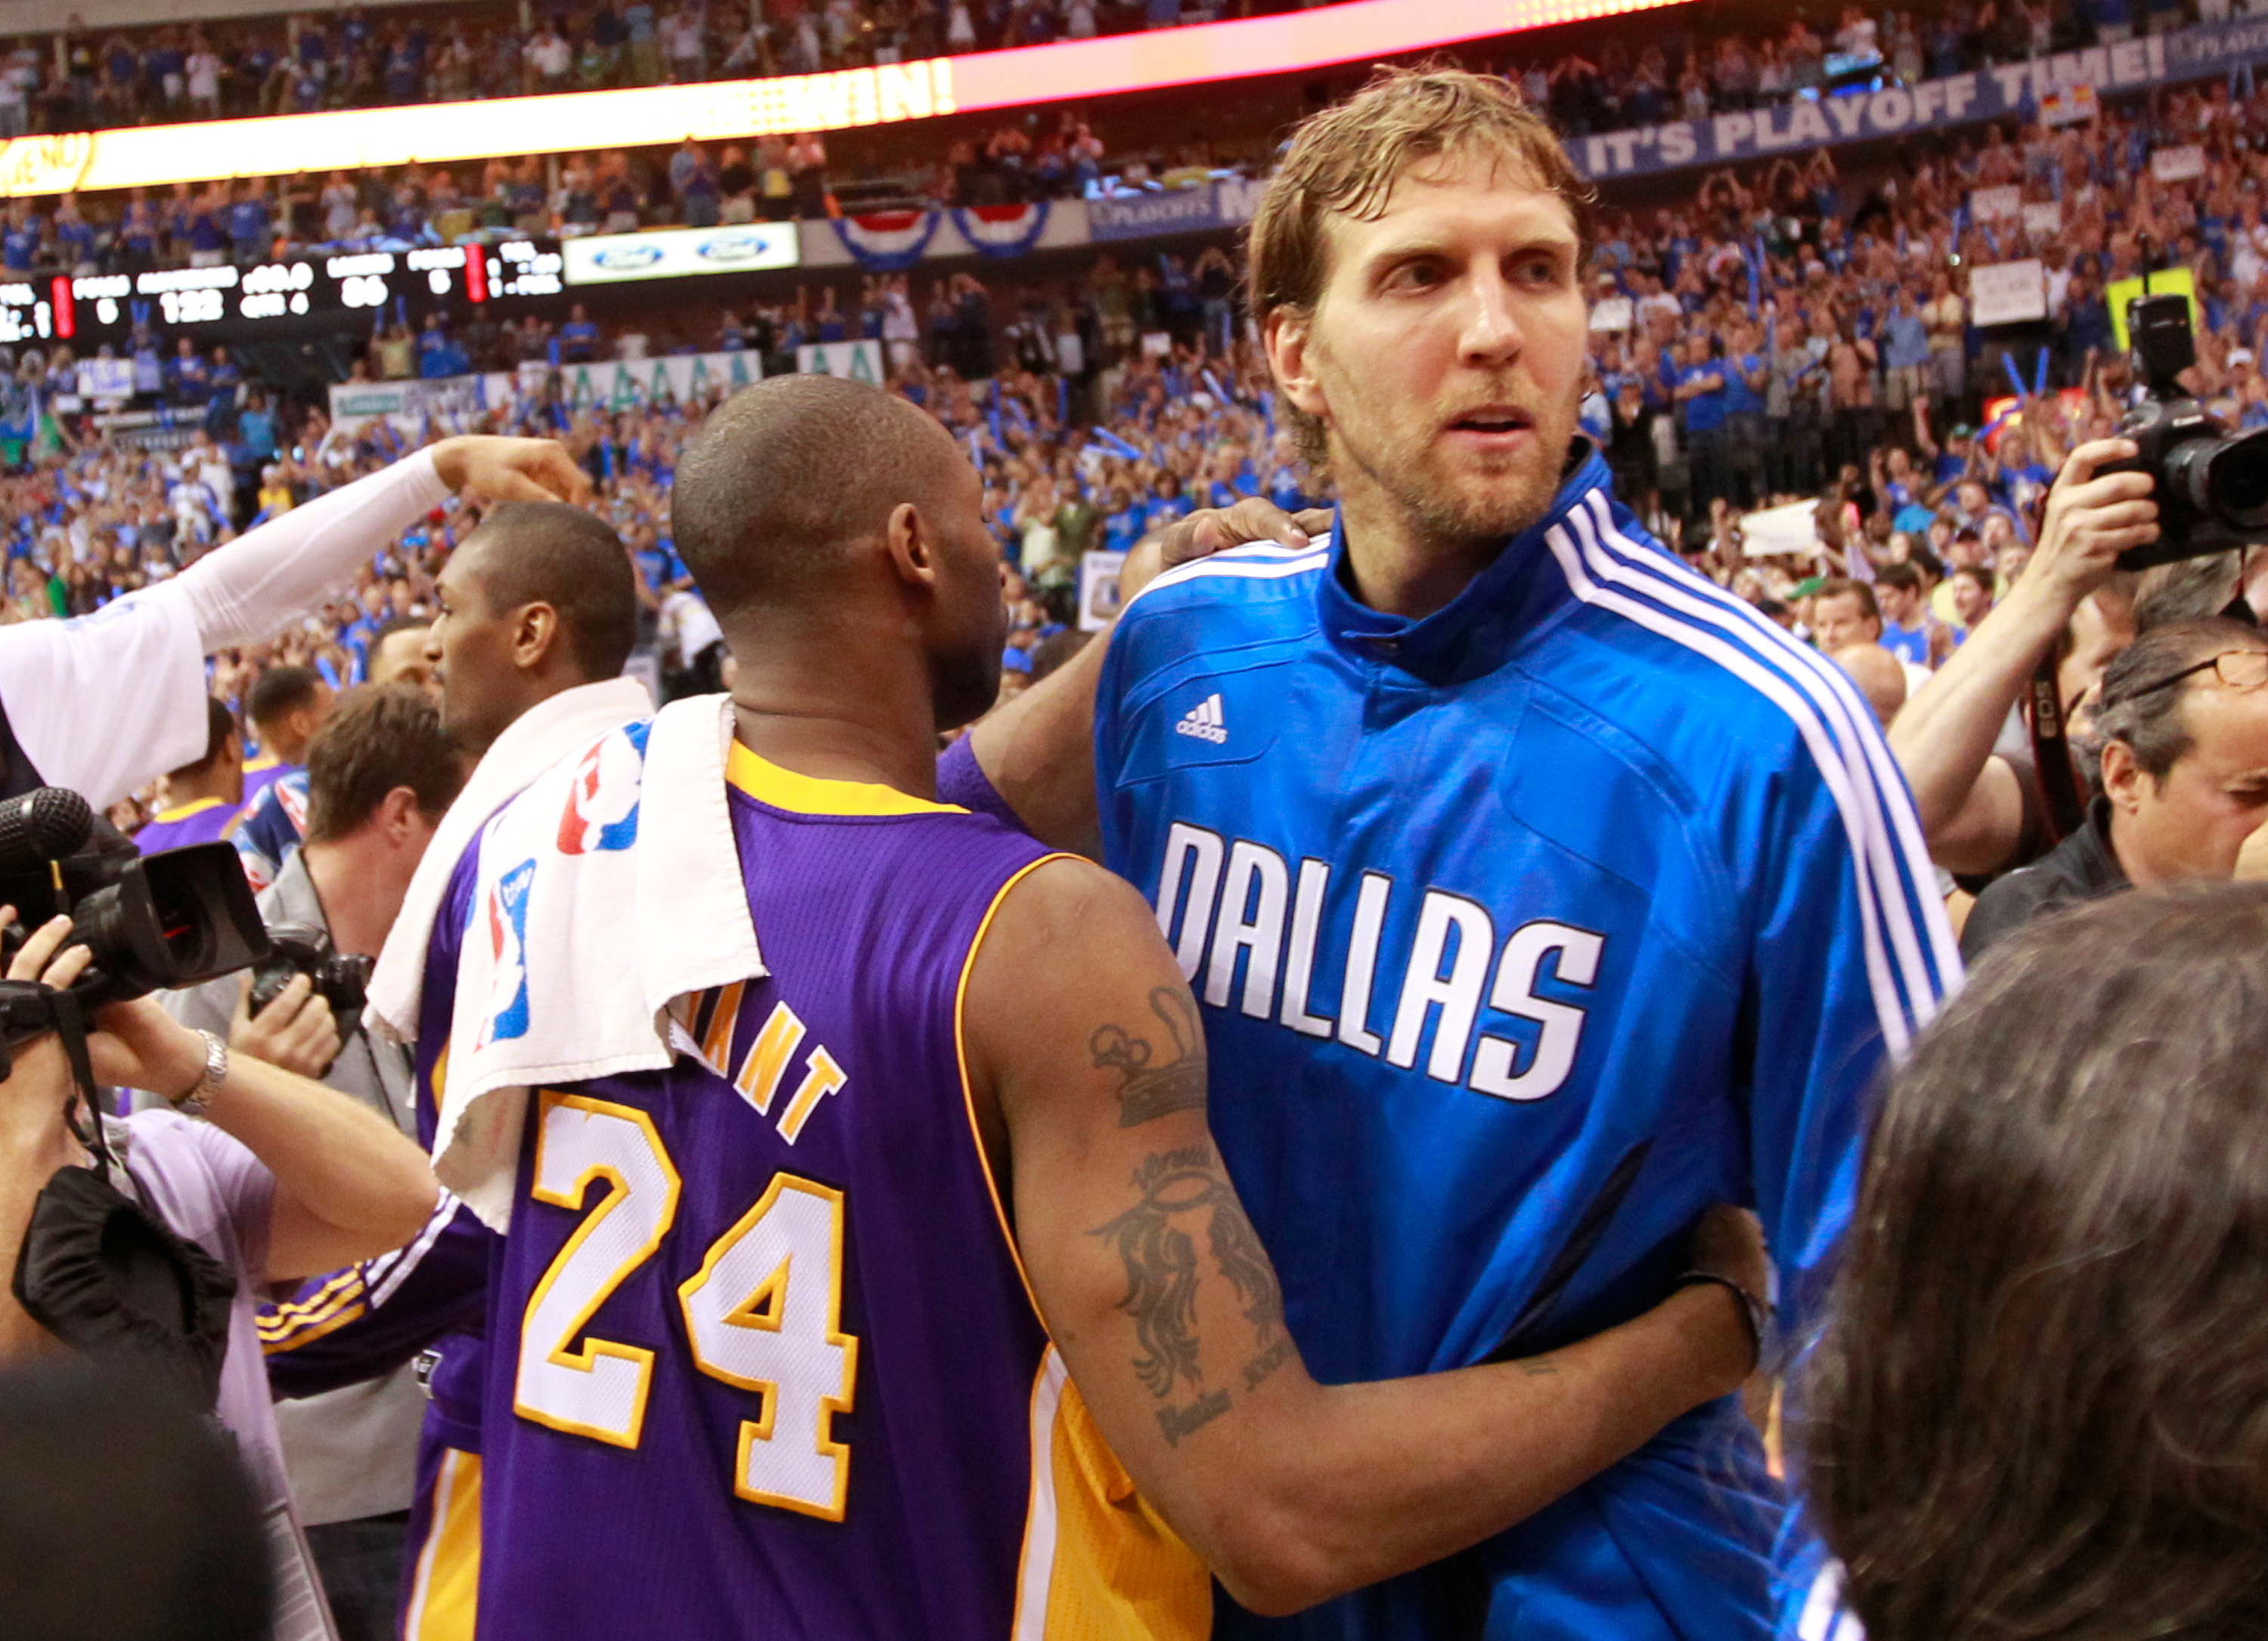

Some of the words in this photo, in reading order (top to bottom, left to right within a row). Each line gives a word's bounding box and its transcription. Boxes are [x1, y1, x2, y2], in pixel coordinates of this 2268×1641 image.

[1585, 119, 1698, 175] IT'S
[1714, 73, 1977, 156] PLAYOFF
[1991, 35, 2166, 106] TIME!
[1176, 720, 1228, 745] adidas
[1157, 820, 1606, 1102] DALLAS
[513, 1089, 859, 1522] 24
